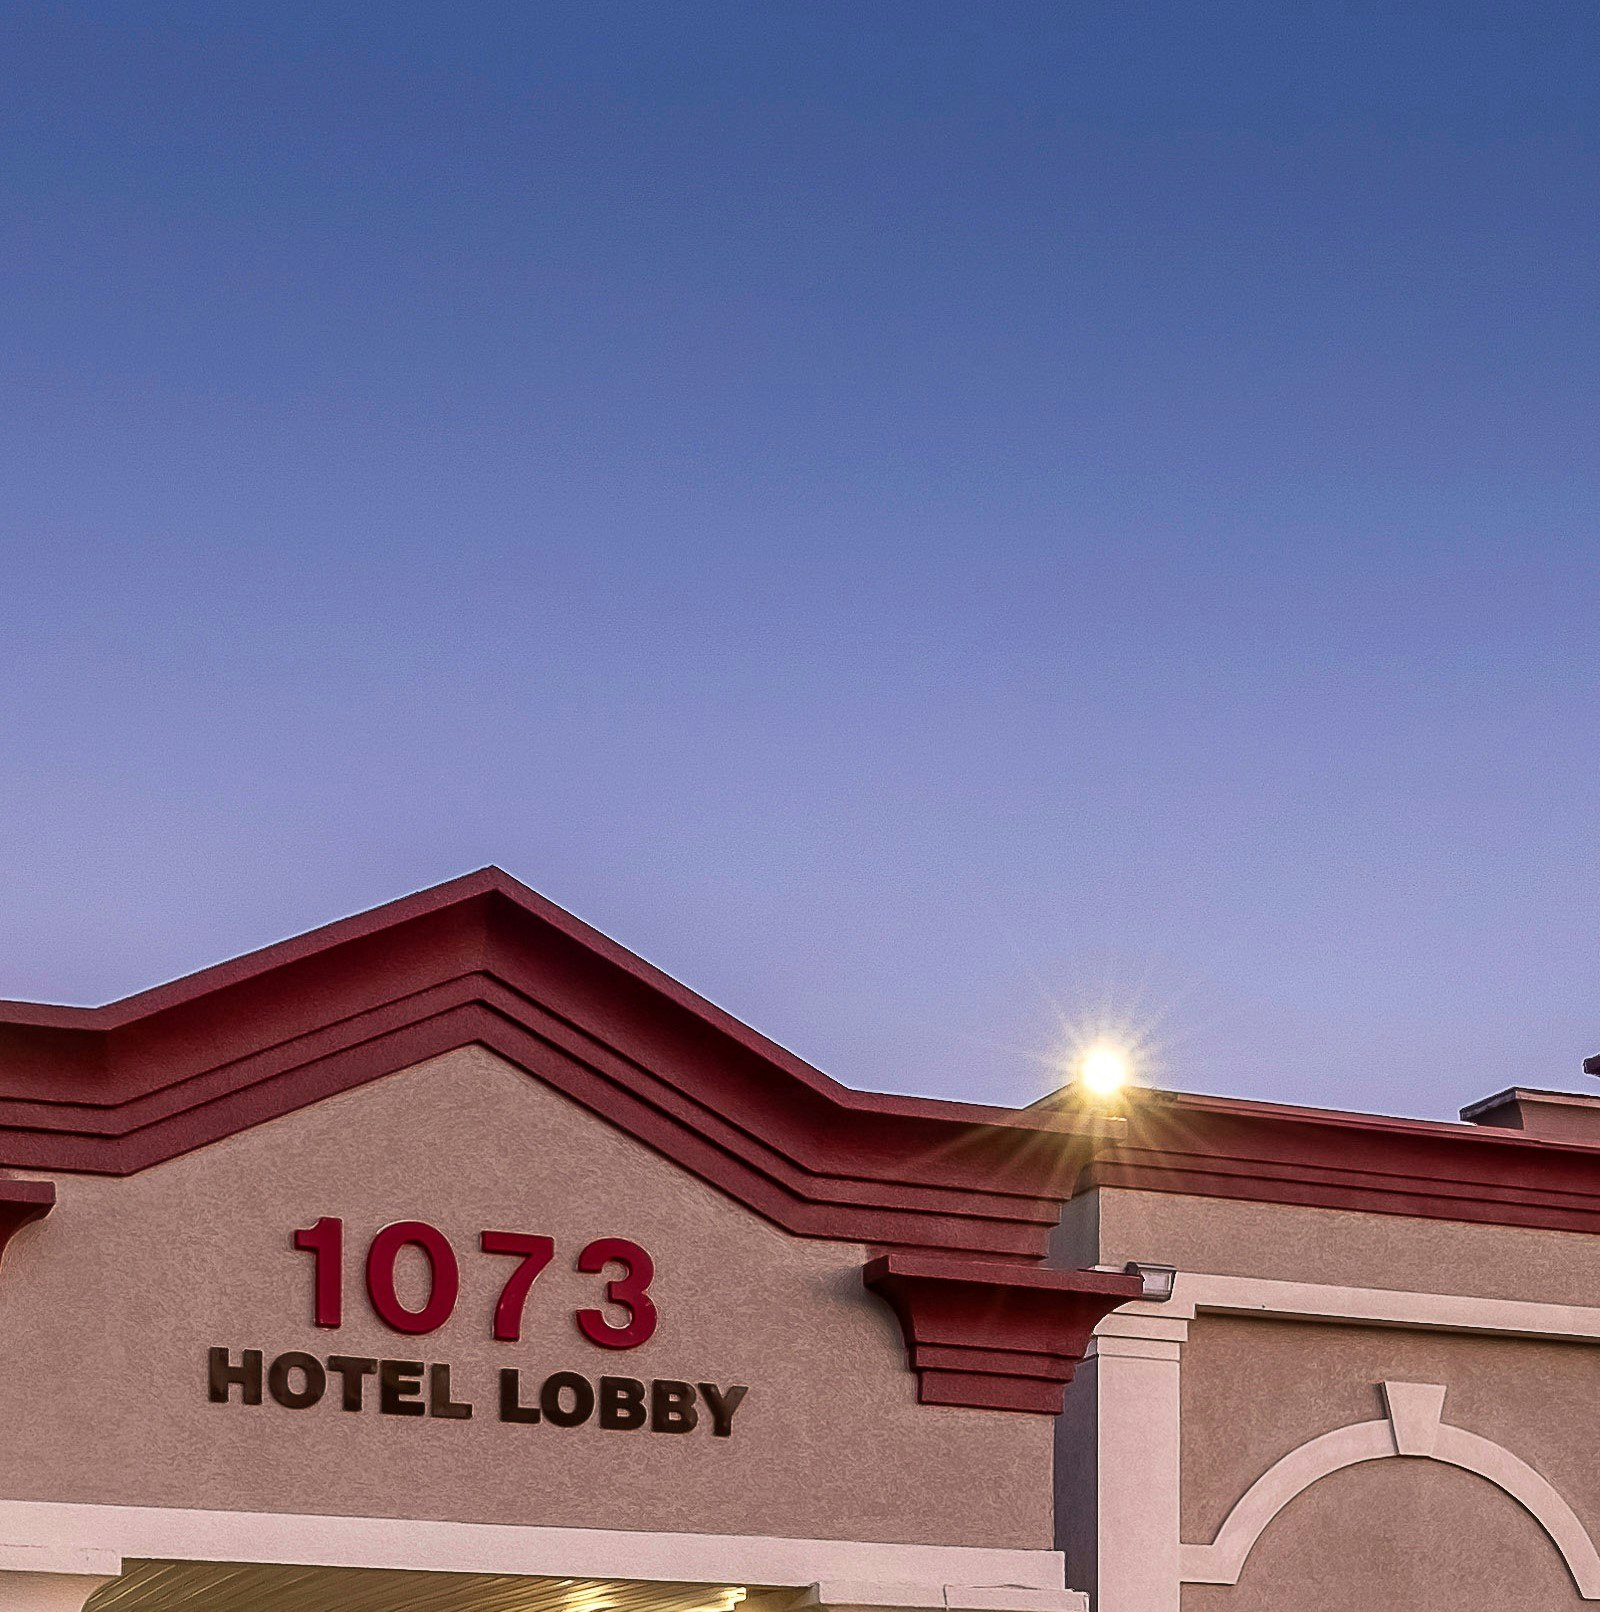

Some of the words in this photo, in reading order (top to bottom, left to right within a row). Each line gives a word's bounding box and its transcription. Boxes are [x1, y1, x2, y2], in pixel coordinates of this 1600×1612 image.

[294, 1216, 658, 1350] 1073
[209, 1346, 473, 1419] HOTEL
[500, 1368, 749, 1438] LOBBY
